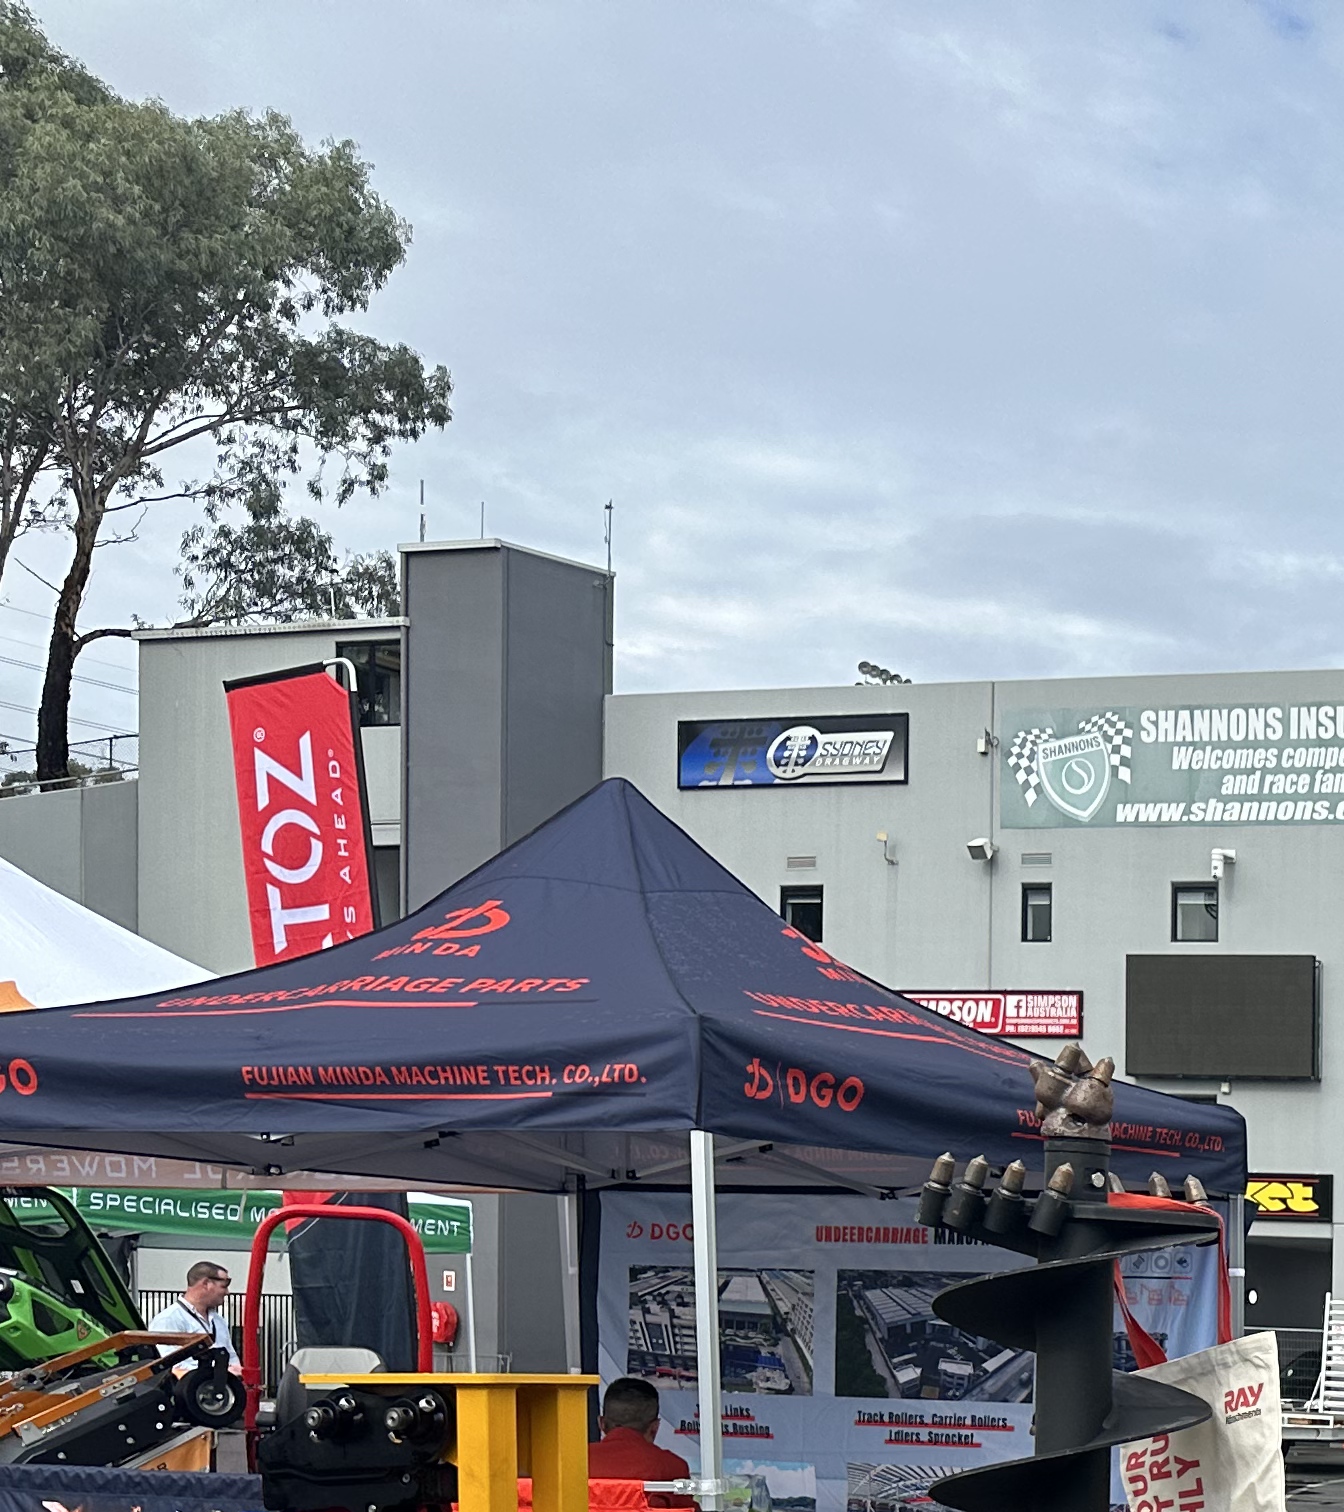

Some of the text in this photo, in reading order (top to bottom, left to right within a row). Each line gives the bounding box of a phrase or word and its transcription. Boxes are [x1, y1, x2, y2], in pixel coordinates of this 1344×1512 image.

[1139, 707, 1284, 743] SHANNONS
[819, 739, 888, 757] SYDNEY
[1042, 735, 1101, 762] SHANNONS
[1171, 745, 1278, 771] Welcomes
[815, 756, 881, 767] DRAGWAY
[1221, 770, 1262, 796] and
[1263, 773, 1310, 795] race
[328, 760, 352, 885] AHEAD
[254, 730, 334, 954] TOZ
[459, 975, 591, 994] PARTS
[919, 1000, 993, 1023] PSON
[1026, 994, 1077, 1007] SIMPSON
[1026, 1006, 1077, 1018] AUSTRALIA
[241, 1065, 315, 1087] FUJIAN
[318, 1065, 389, 1087] MINDA
[388, 1065, 491, 1087] MACHINE
[493, 1065, 557, 1086] TECH.
[786, 1068, 865, 1112] DGO
[1016, 1109, 1044, 1128] FUJ
[89, 1191, 240, 1222] SPECIALISED
[1224, 1382, 1264, 1414] RAY
[857, 1409, 885, 1424] Track
[931, 1413, 968, 1427] Carrier
[970, 1414, 1008, 1429] Rollers
[928, 1431, 974, 1446] Sprocket
